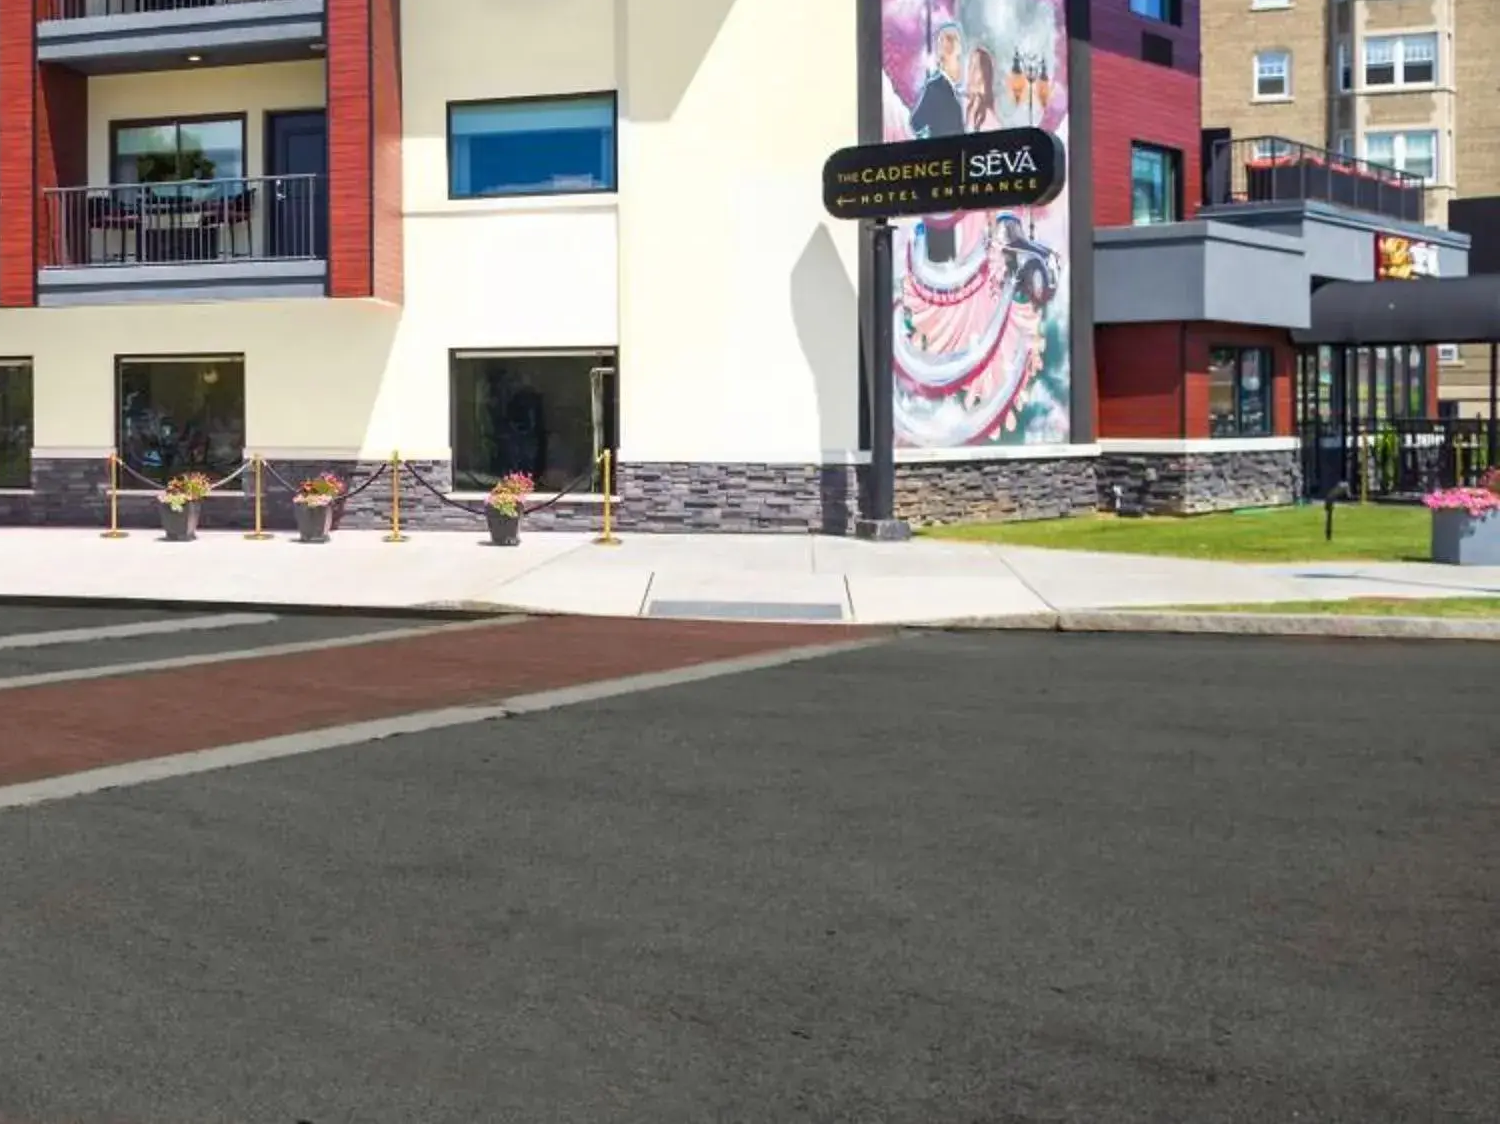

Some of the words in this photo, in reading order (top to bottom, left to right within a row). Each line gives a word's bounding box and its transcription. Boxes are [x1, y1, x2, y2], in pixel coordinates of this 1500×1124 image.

[837, 171, 860, 183] THE
[861, 160, 953, 183] CADENCE
[861, 190, 919, 204] HOTEL
[931, 179, 1038, 199] ENTRANCE
